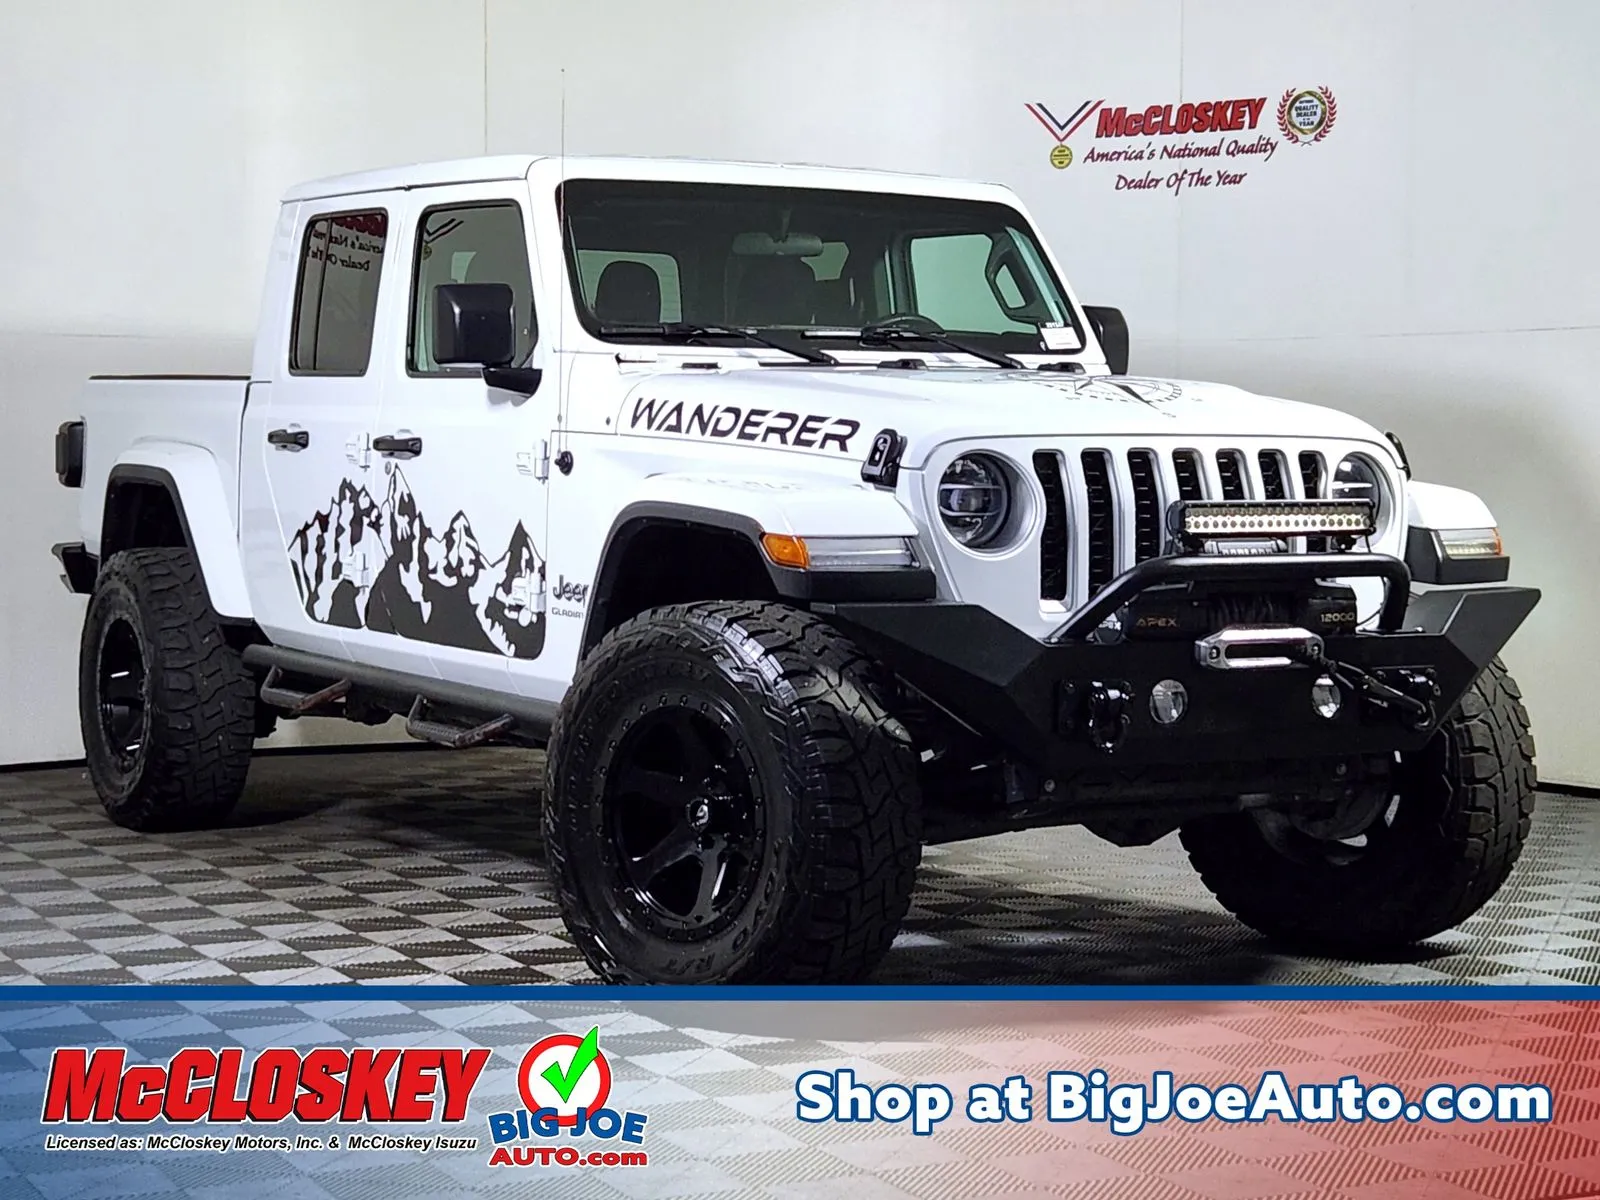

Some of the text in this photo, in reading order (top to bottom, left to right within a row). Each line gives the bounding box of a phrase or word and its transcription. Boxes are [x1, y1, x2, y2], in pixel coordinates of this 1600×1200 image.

[1096, 97, 1267, 138] McCLOSKEY
[1083, 134, 1279, 164] America's National Quality
[1115, 168, 1248, 197] Dealer Of The Year
[630, 397, 861, 453] WANDERER
[1136, 617, 1178, 627] APEX
[1320, 611, 1356, 623] 12000
